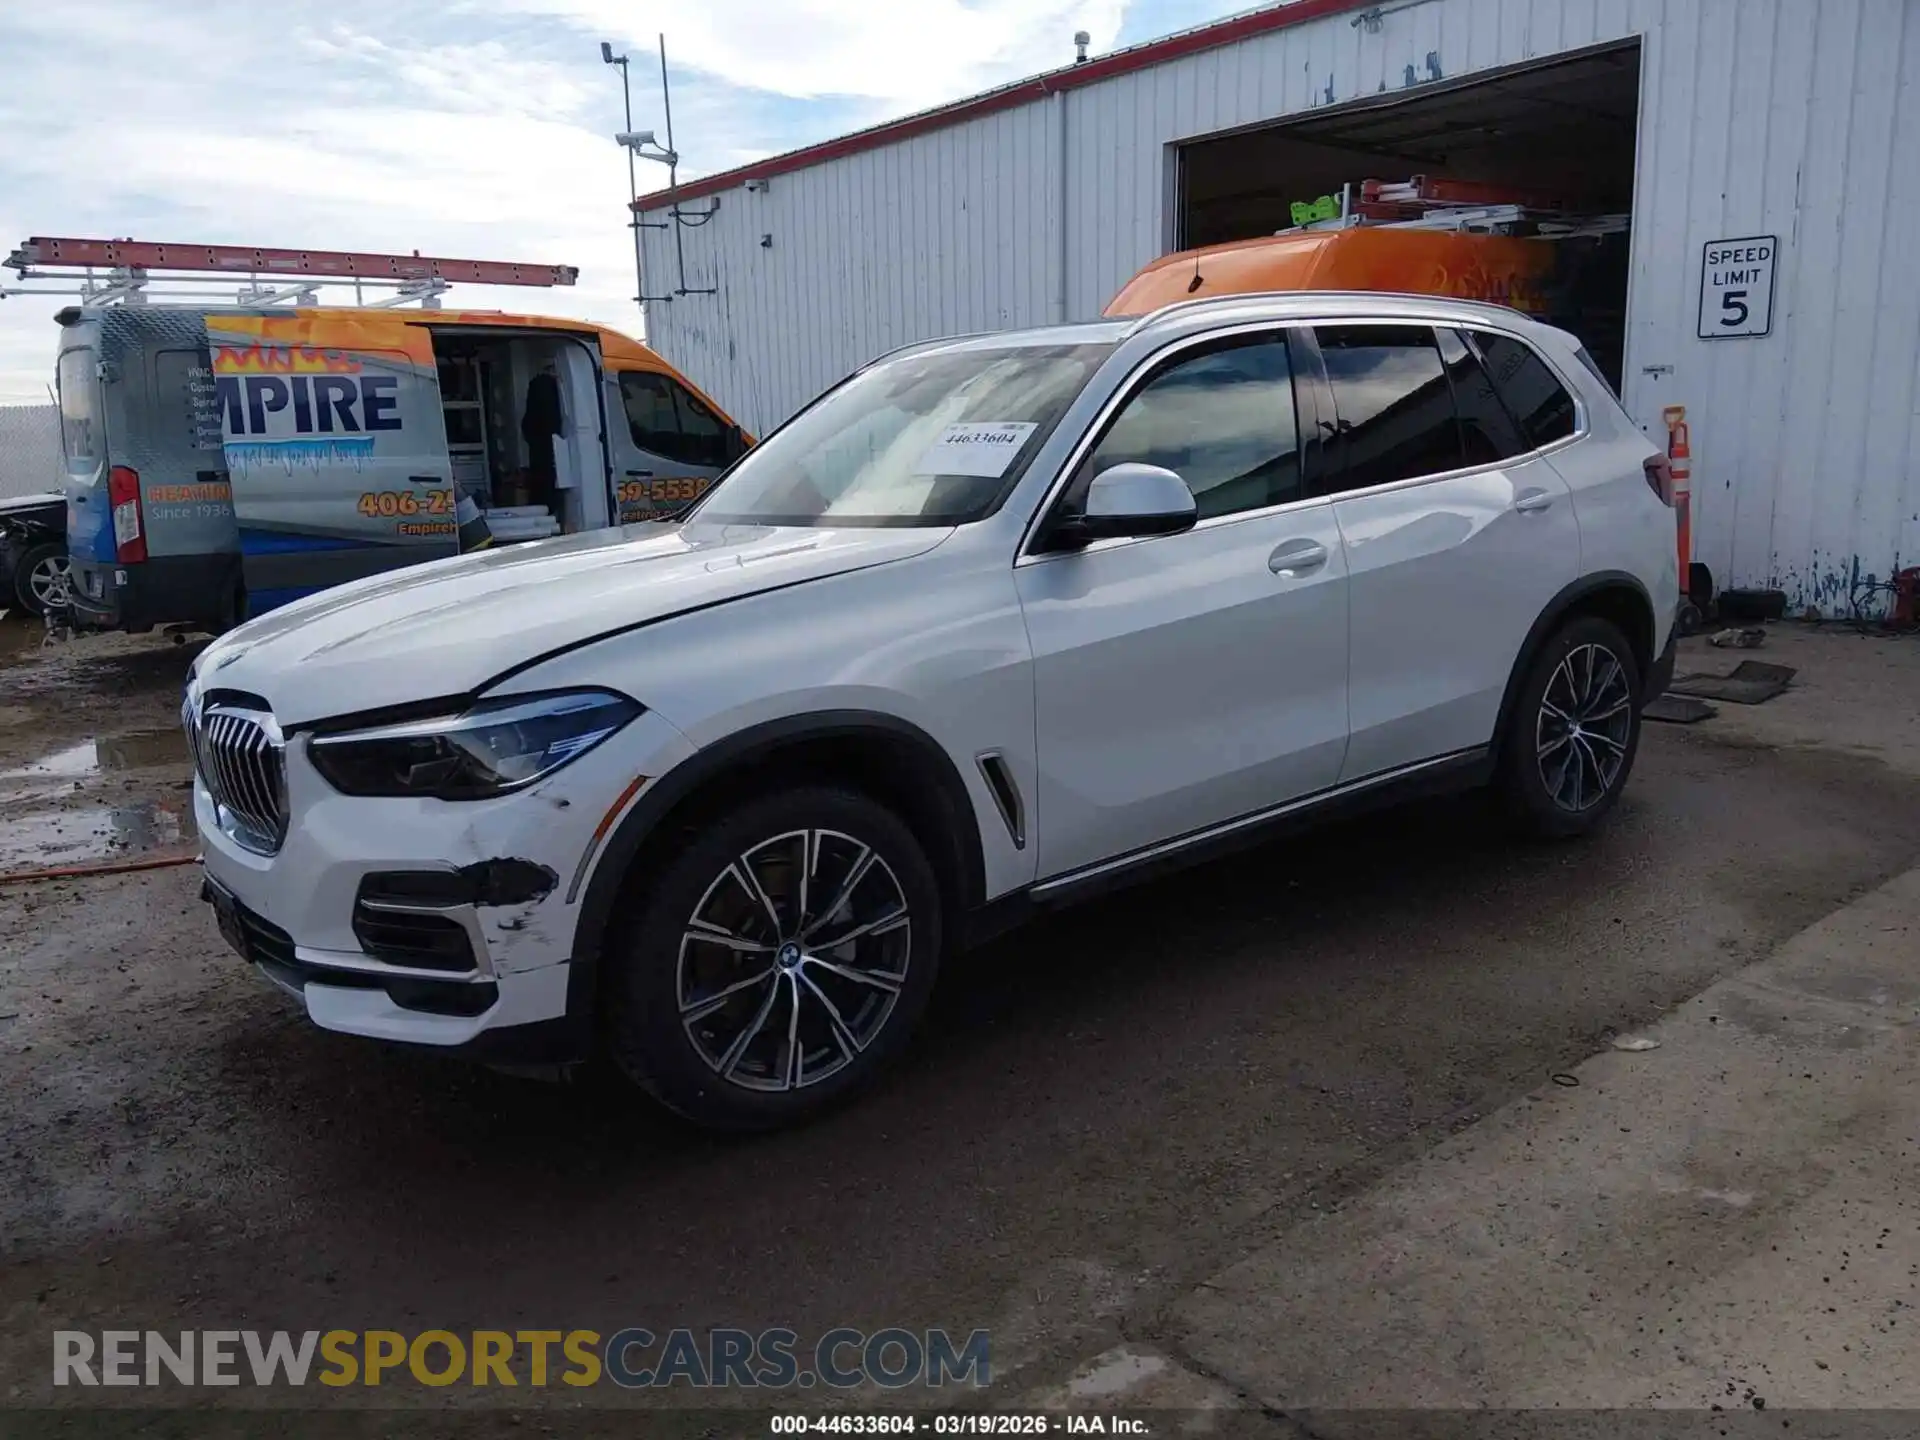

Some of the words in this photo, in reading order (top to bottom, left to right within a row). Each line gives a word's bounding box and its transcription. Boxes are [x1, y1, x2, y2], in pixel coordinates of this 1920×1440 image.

[1708, 247, 1770, 264] SPEED
[1713, 269, 1761, 285] LIMIT
[1720, 291, 1748, 326] 5
[946, 432, 1016, 444] 44633604
[152, 506, 191, 520] Since
[196, 504, 231, 517] 1936
